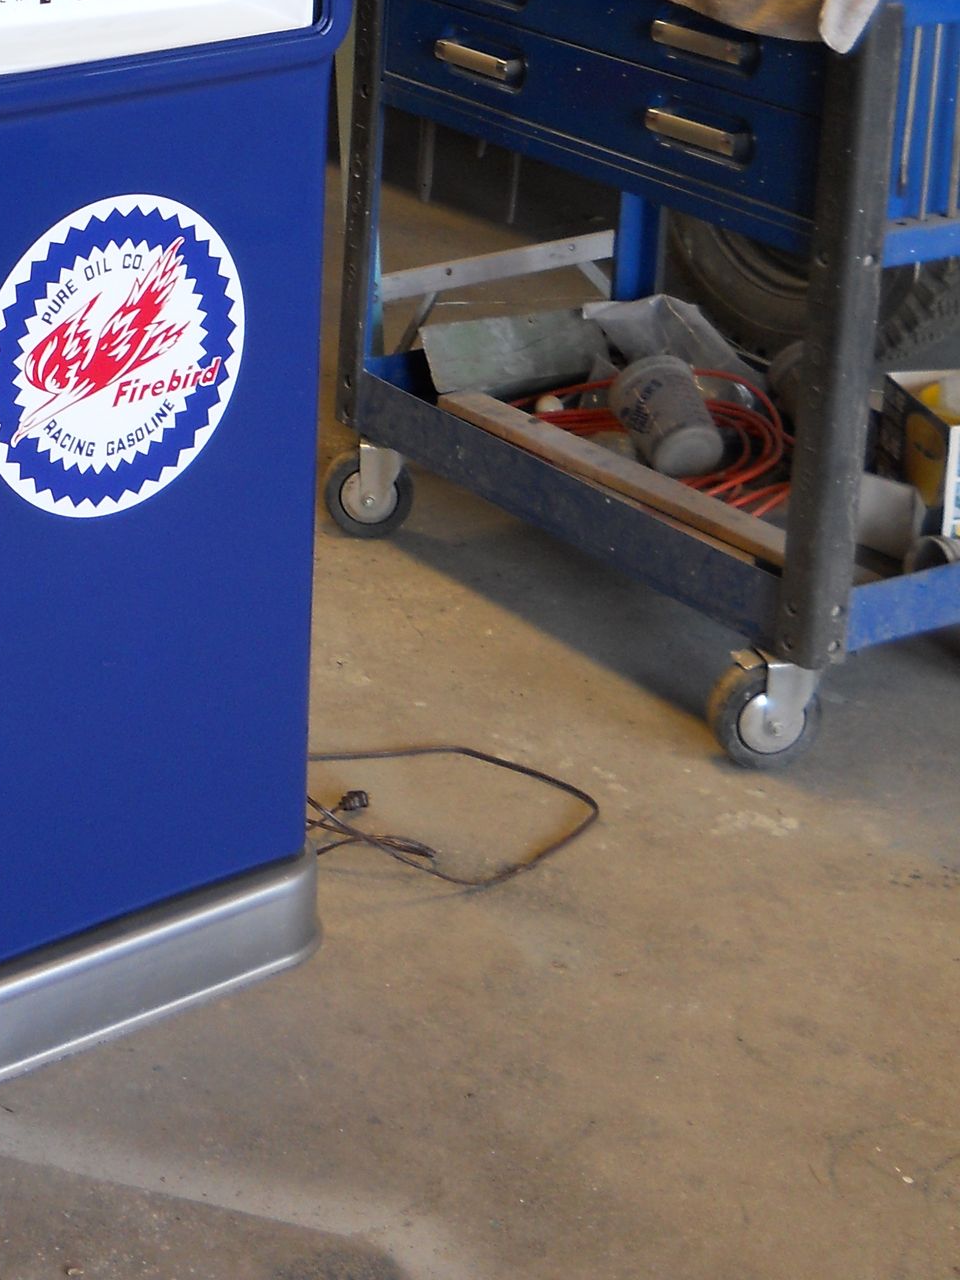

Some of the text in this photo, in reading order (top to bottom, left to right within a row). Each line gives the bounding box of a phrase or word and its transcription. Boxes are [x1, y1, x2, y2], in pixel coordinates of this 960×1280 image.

[41, 253, 145, 325] PURE OIL CO.
[112, 357, 222, 408] Firebird
[43, 398, 175, 457] RACING GASOLINE
